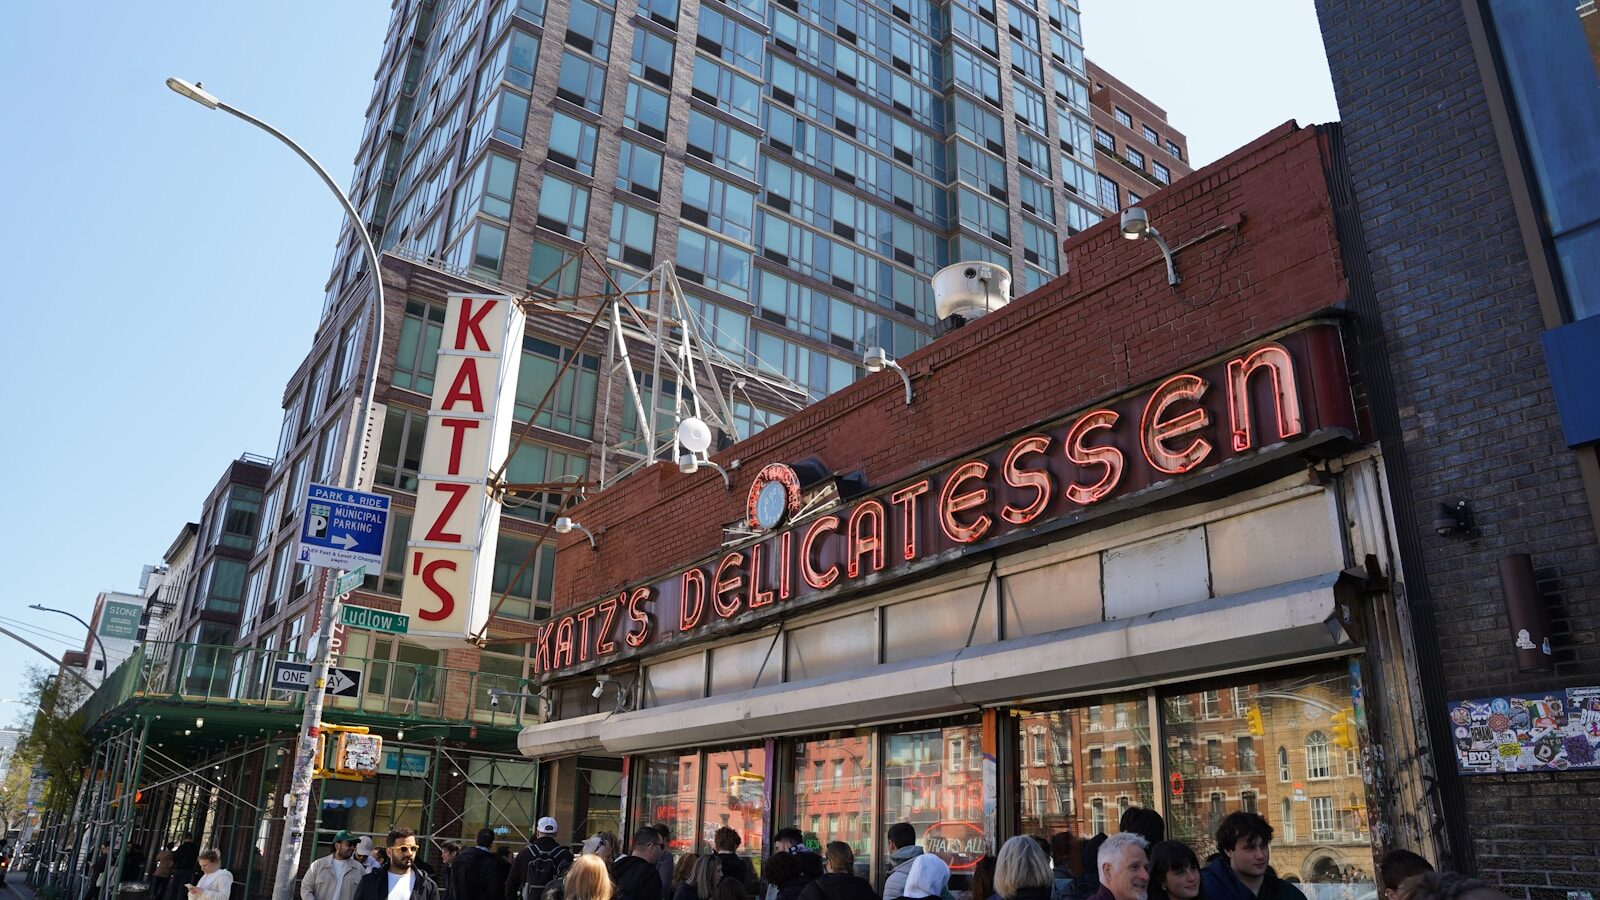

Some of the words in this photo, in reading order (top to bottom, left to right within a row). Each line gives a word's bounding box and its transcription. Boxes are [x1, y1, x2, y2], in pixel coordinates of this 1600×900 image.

[412, 298, 498, 622] KATZ'S
[315, 489, 343, 500] PARK
[348, 495, 355, 503] &
[360, 497, 382, 508] RIDE
[334, 507, 382, 524] MUNICIPAL
[333, 518, 372, 533] PARKING
[358, 555, 382, 565] Charging
[342, 607, 392, 630] Ludlow
[397, 616, 407, 628] St
[534, 586, 651, 674] KATZ'S
[282, 670, 306, 684] ONE
[1468, 751, 1490, 760] BYO
